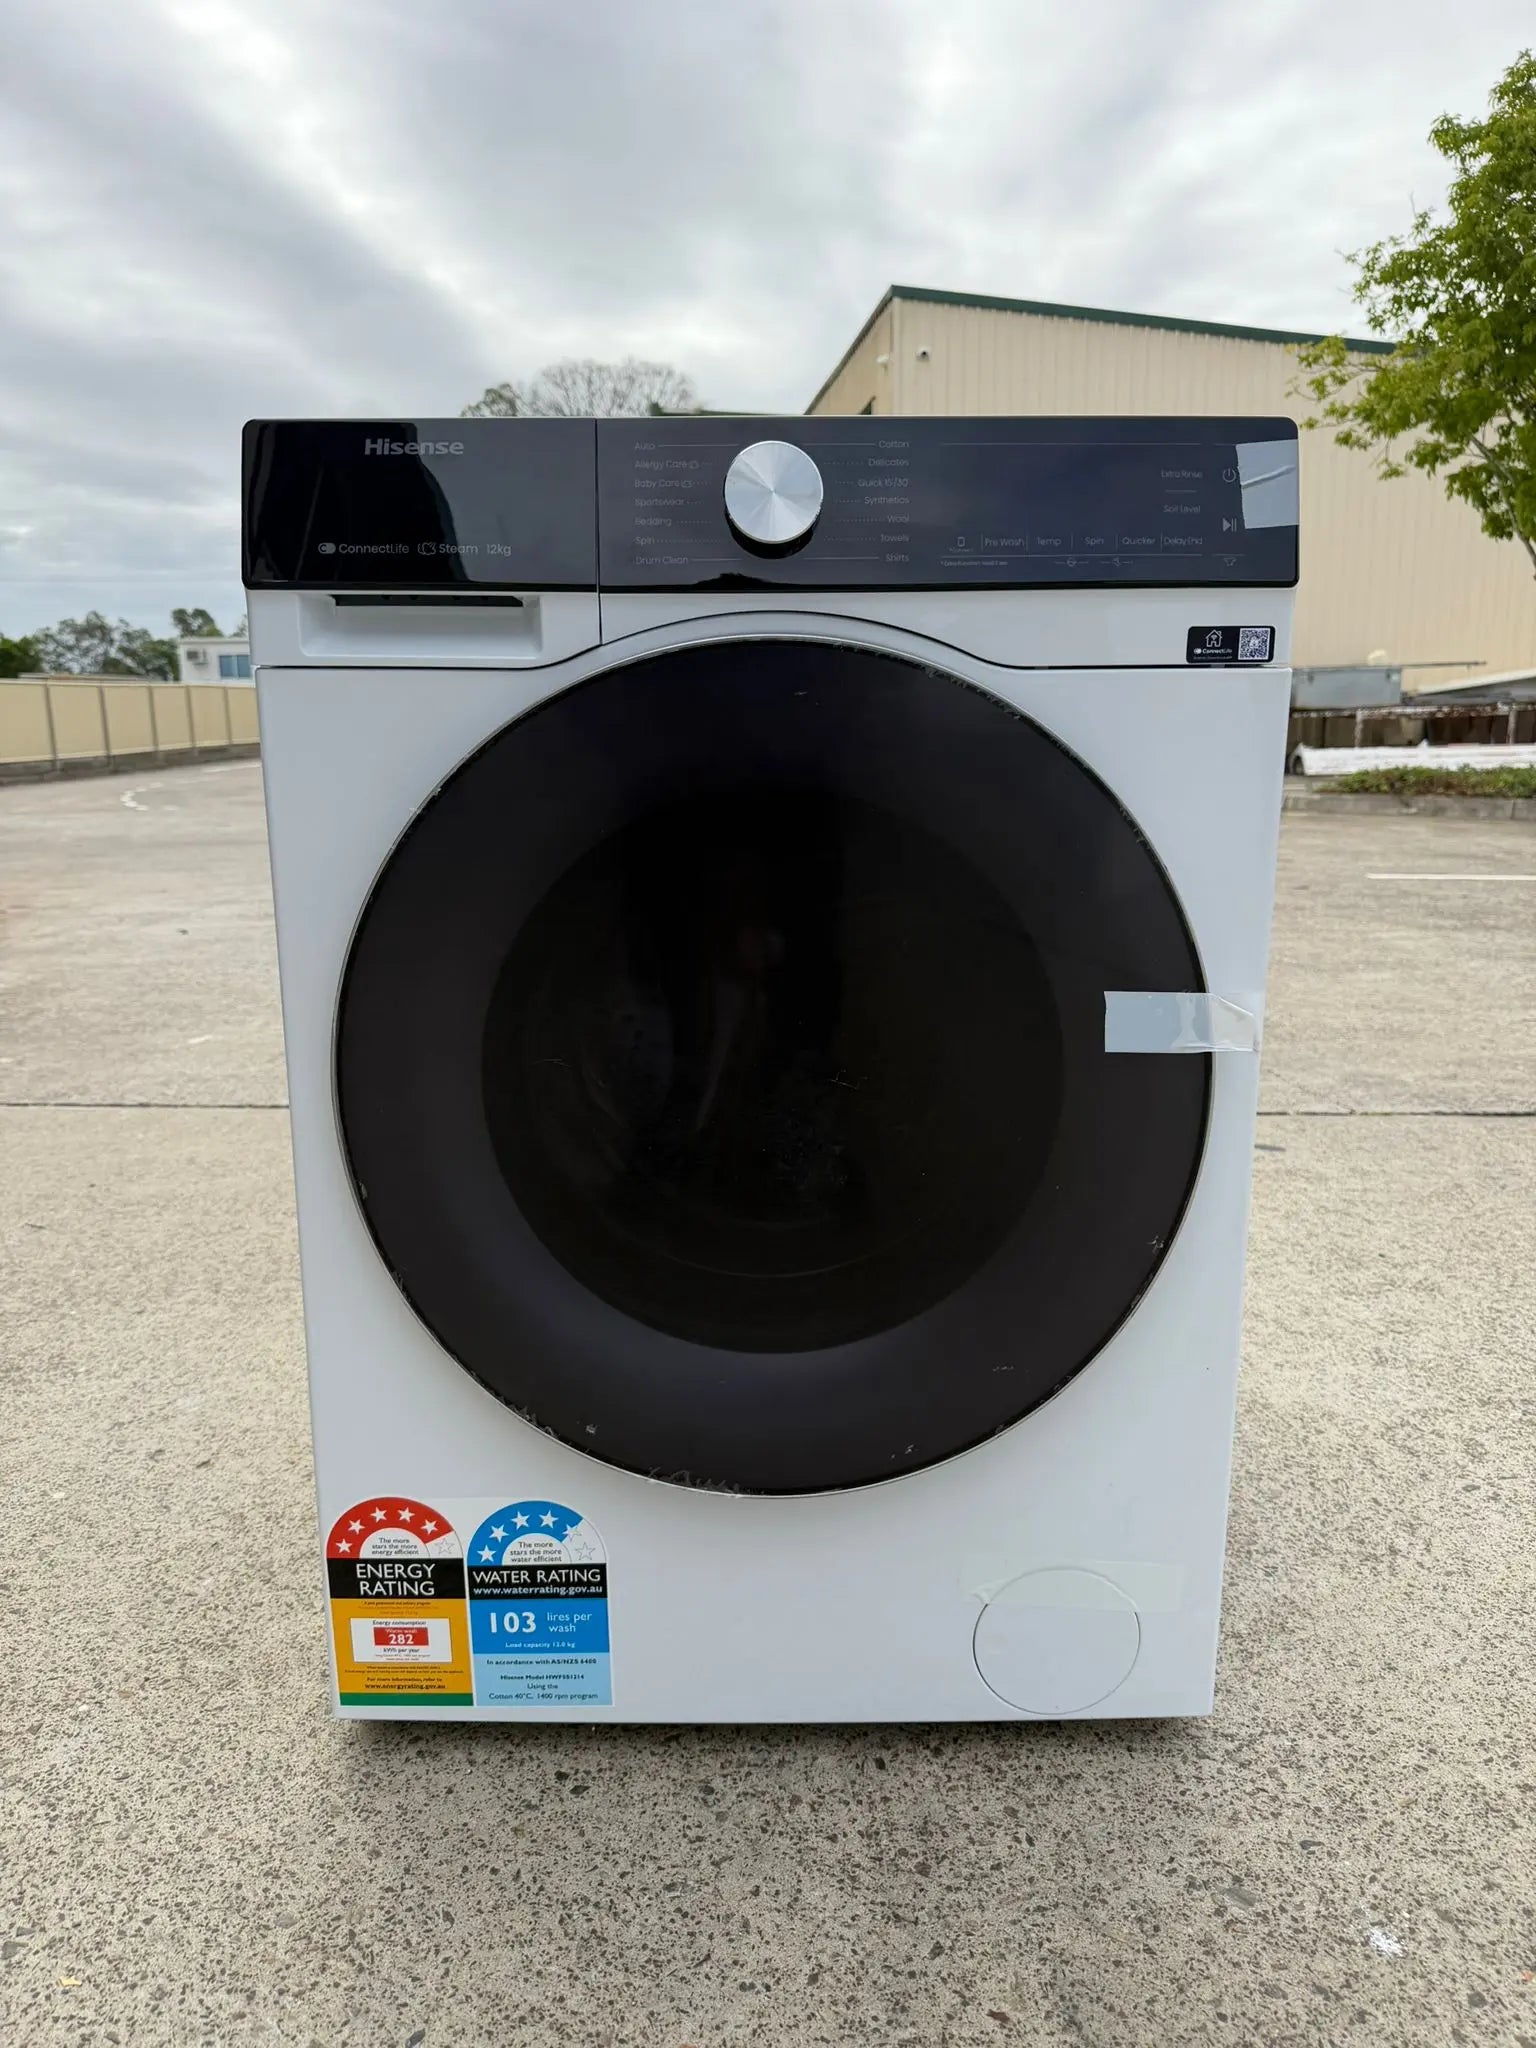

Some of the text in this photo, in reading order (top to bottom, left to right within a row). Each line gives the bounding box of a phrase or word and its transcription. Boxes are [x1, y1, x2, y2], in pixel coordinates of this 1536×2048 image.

[364, 438, 464, 456] Hisense
[634, 442, 656, 450] Auto
[878, 440, 909, 449] Cotton
[868, 458, 909, 467] Delicates
[634, 480, 656, 489] Baby
[857, 479, 882, 488] Quick
[635, 498, 684, 508] Sportswear
[864, 496, 910, 506] Synthetics
[635, 518, 672, 528] Bedding
[886, 515, 909, 524] Wool
[635, 536, 655, 546] Spin
[880, 533, 909, 542] Towels
[1000, 536, 1025, 547] Wash
[1037, 537, 1061, 548] Temp
[1084, 536, 1104, 548] Spin
[1122, 536, 1156, 546] Quicker
[338, 542, 409, 555] ConnectLife
[439, 543, 478, 555] Steam
[486, 544, 512, 557] 12kg
[635, 556, 688, 565] Drum Clean
[356, 1563, 436, 1579] ENERGY
[472, 1568, 601, 1584] WATER RATING
[360, 1581, 435, 1596] RATING
[473, 1585, 602, 1596] www.waterrating.gov.au
[489, 1612, 536, 1633] 103
[547, 1612, 592, 1623] lires per
[548, 1624, 576, 1632] wash
[388, 1634, 414, 1644] 282
